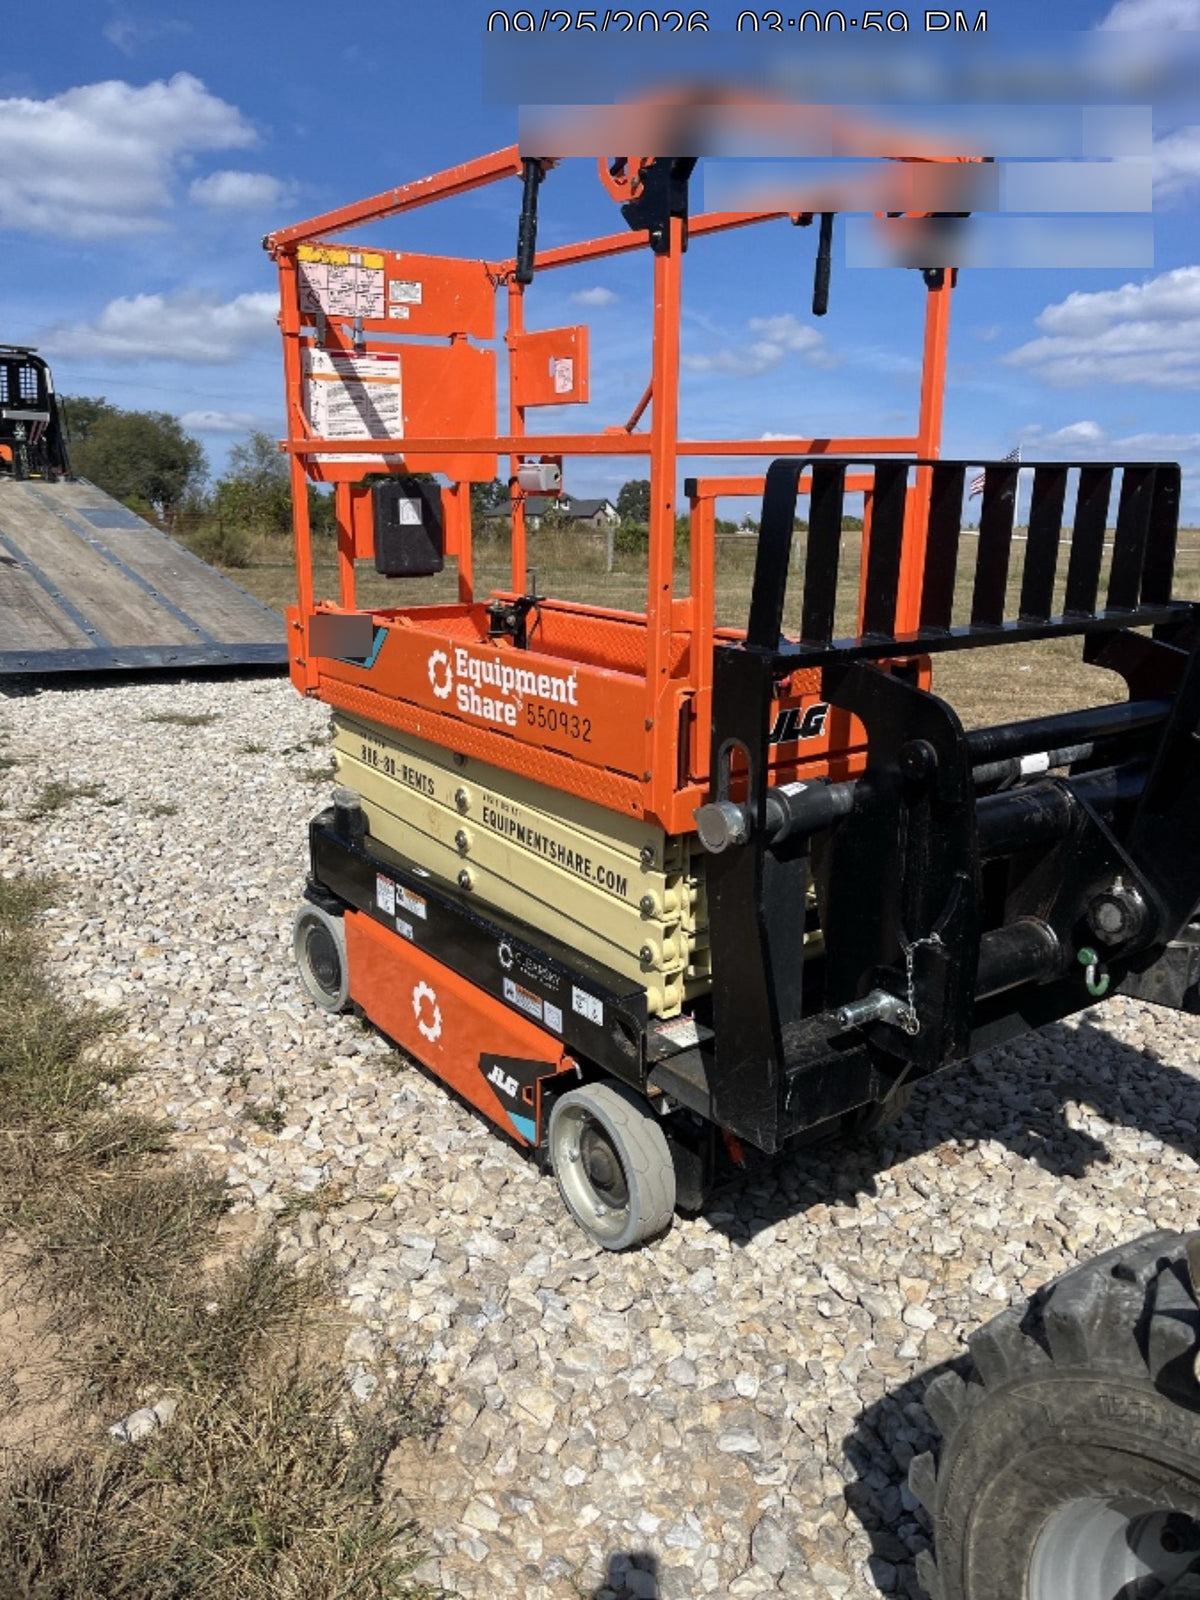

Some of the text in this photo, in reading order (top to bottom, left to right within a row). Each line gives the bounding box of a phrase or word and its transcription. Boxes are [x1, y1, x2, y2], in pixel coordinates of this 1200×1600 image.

[454, 648, 578, 706] Equipment
[456, 683, 518, 726] Share
[526, 702, 592, 743] 550932
[769, 702, 831, 746] JLG
[482, 805, 629, 897] EQUIPMENTSHARE.COM
[486, 1063, 520, 1098] JLG
